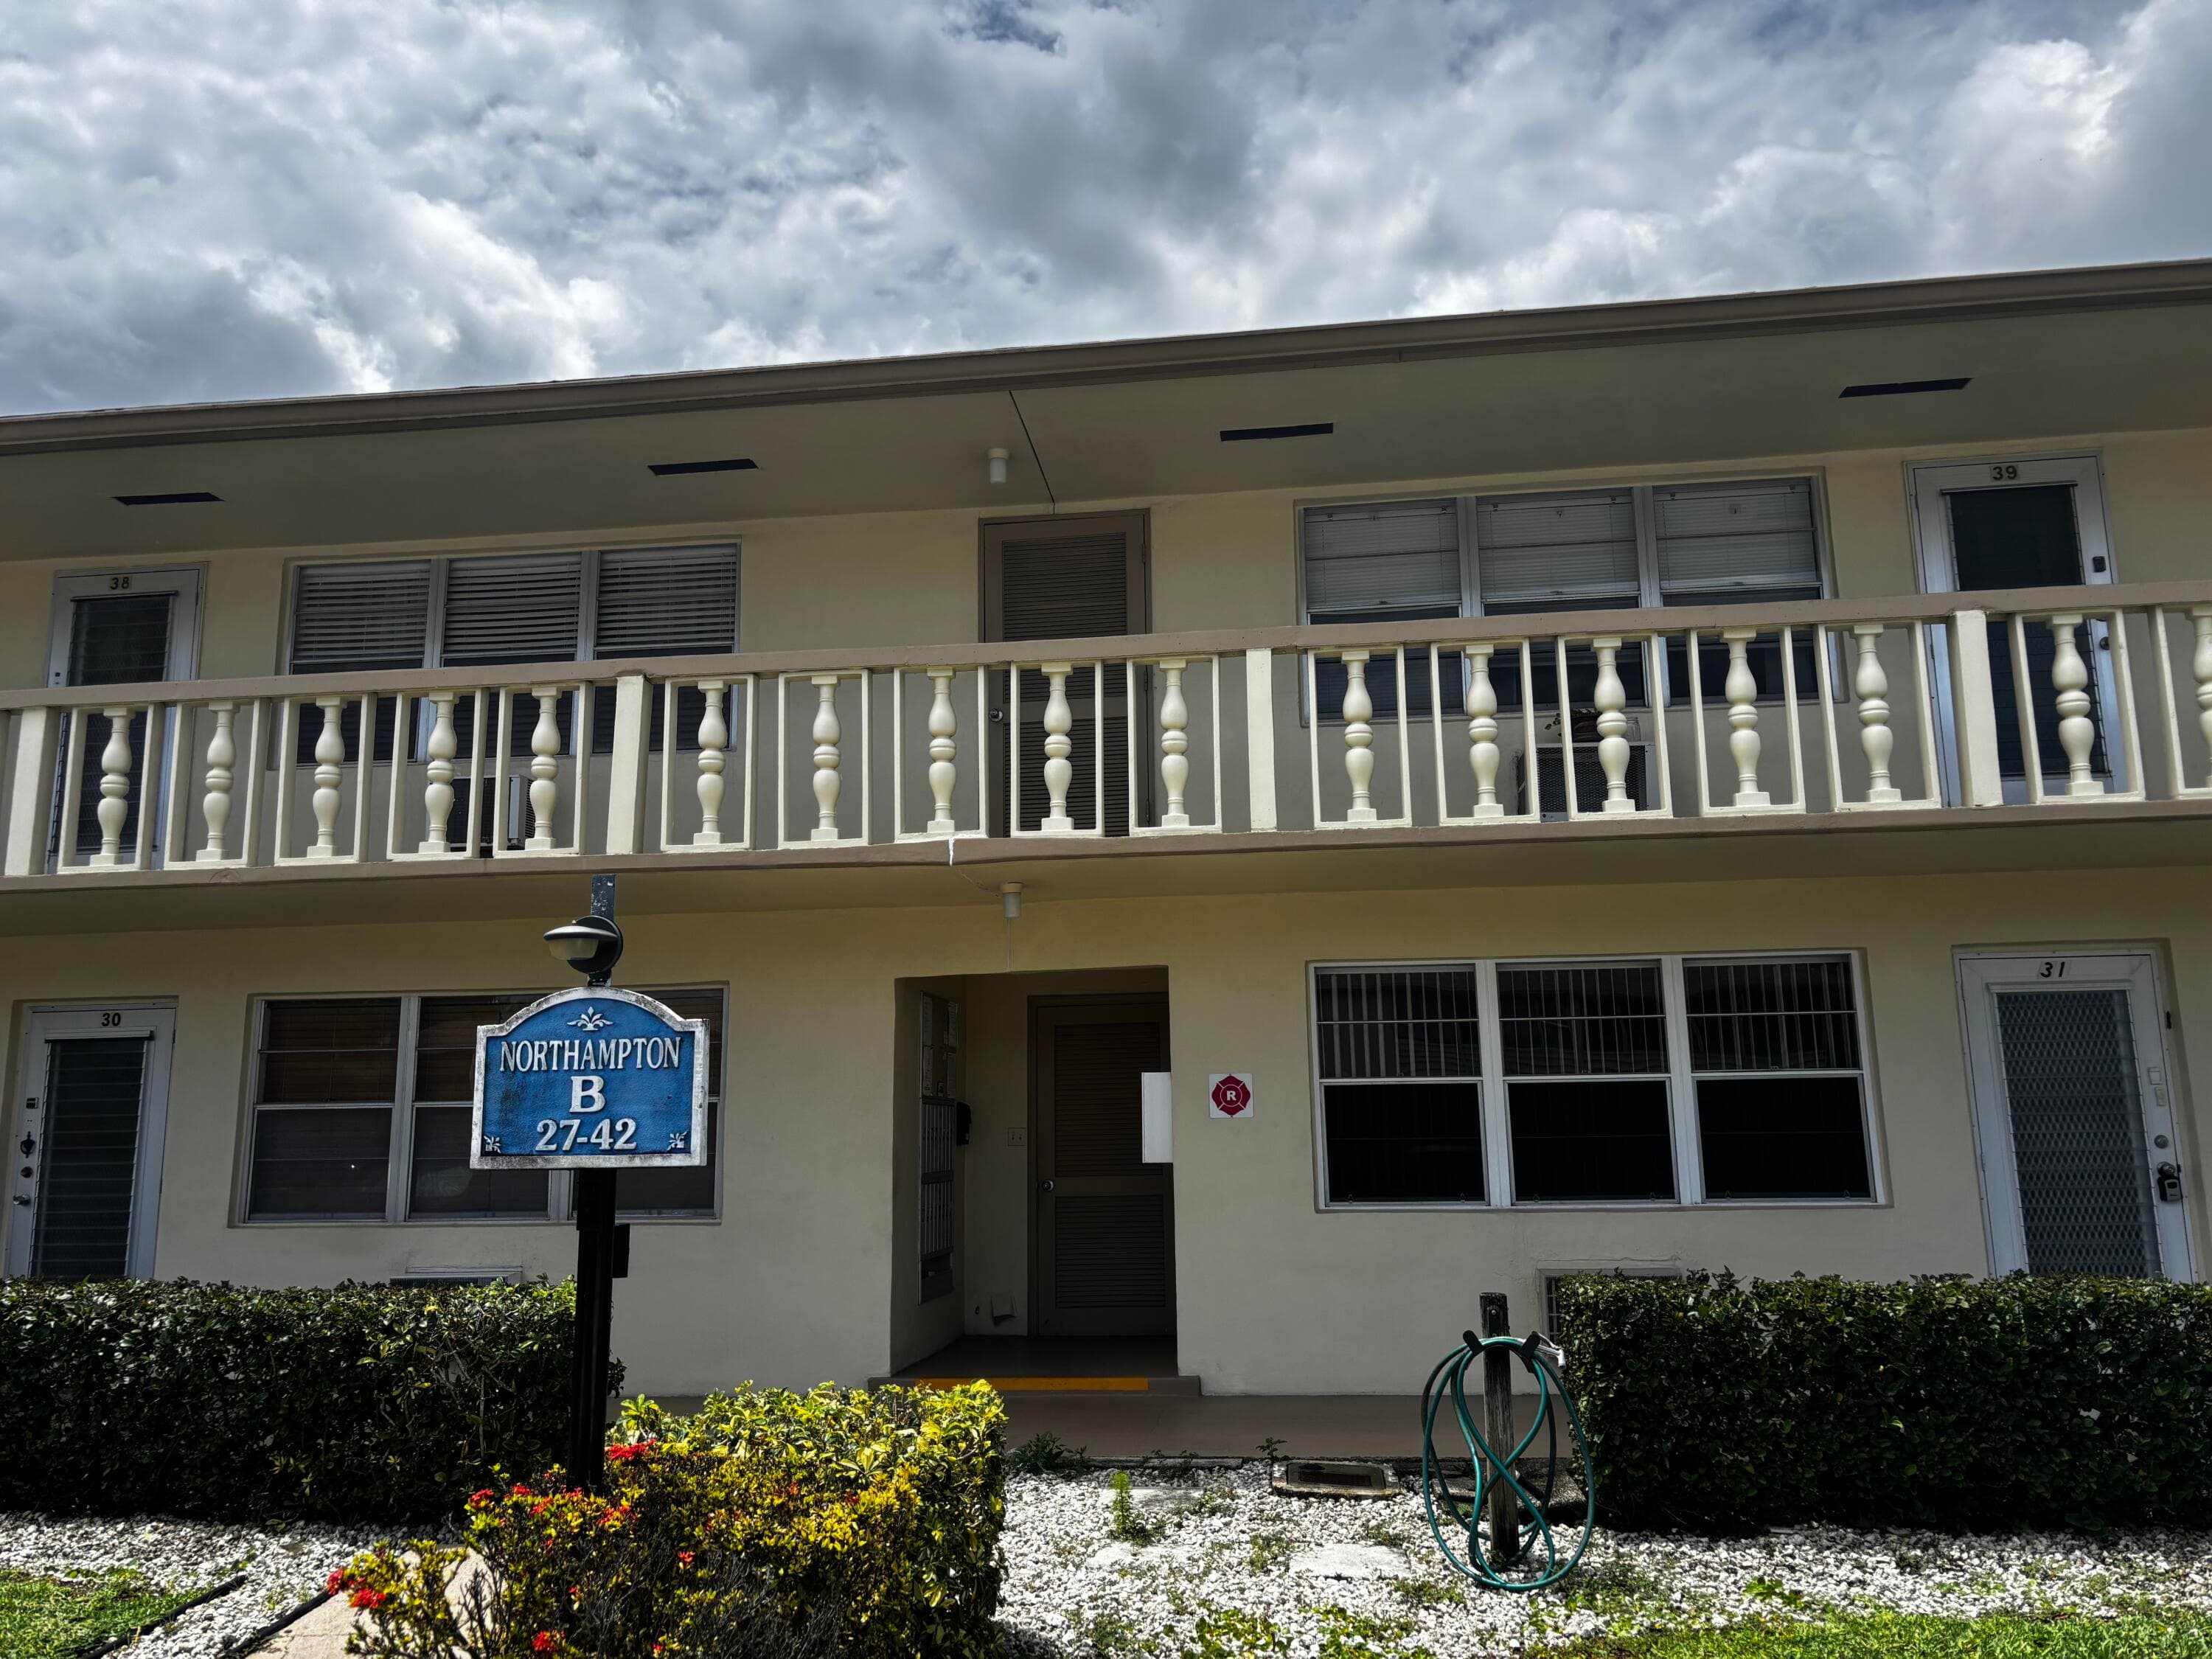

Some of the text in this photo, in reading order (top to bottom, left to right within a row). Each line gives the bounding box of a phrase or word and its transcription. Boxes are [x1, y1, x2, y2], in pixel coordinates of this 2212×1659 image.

[1992, 466, 2017, 481] 39
[110, 577, 130, 590] 38
[2040, 961, 2065, 978] 31
[101, 1012, 122, 1027] 30
[499, 1037, 682, 1072] NORTHAMPTON
[568, 1076, 606, 1113] B
[1226, 1091, 1237, 1101] R
[535, 1118, 637, 1151] 27-42
